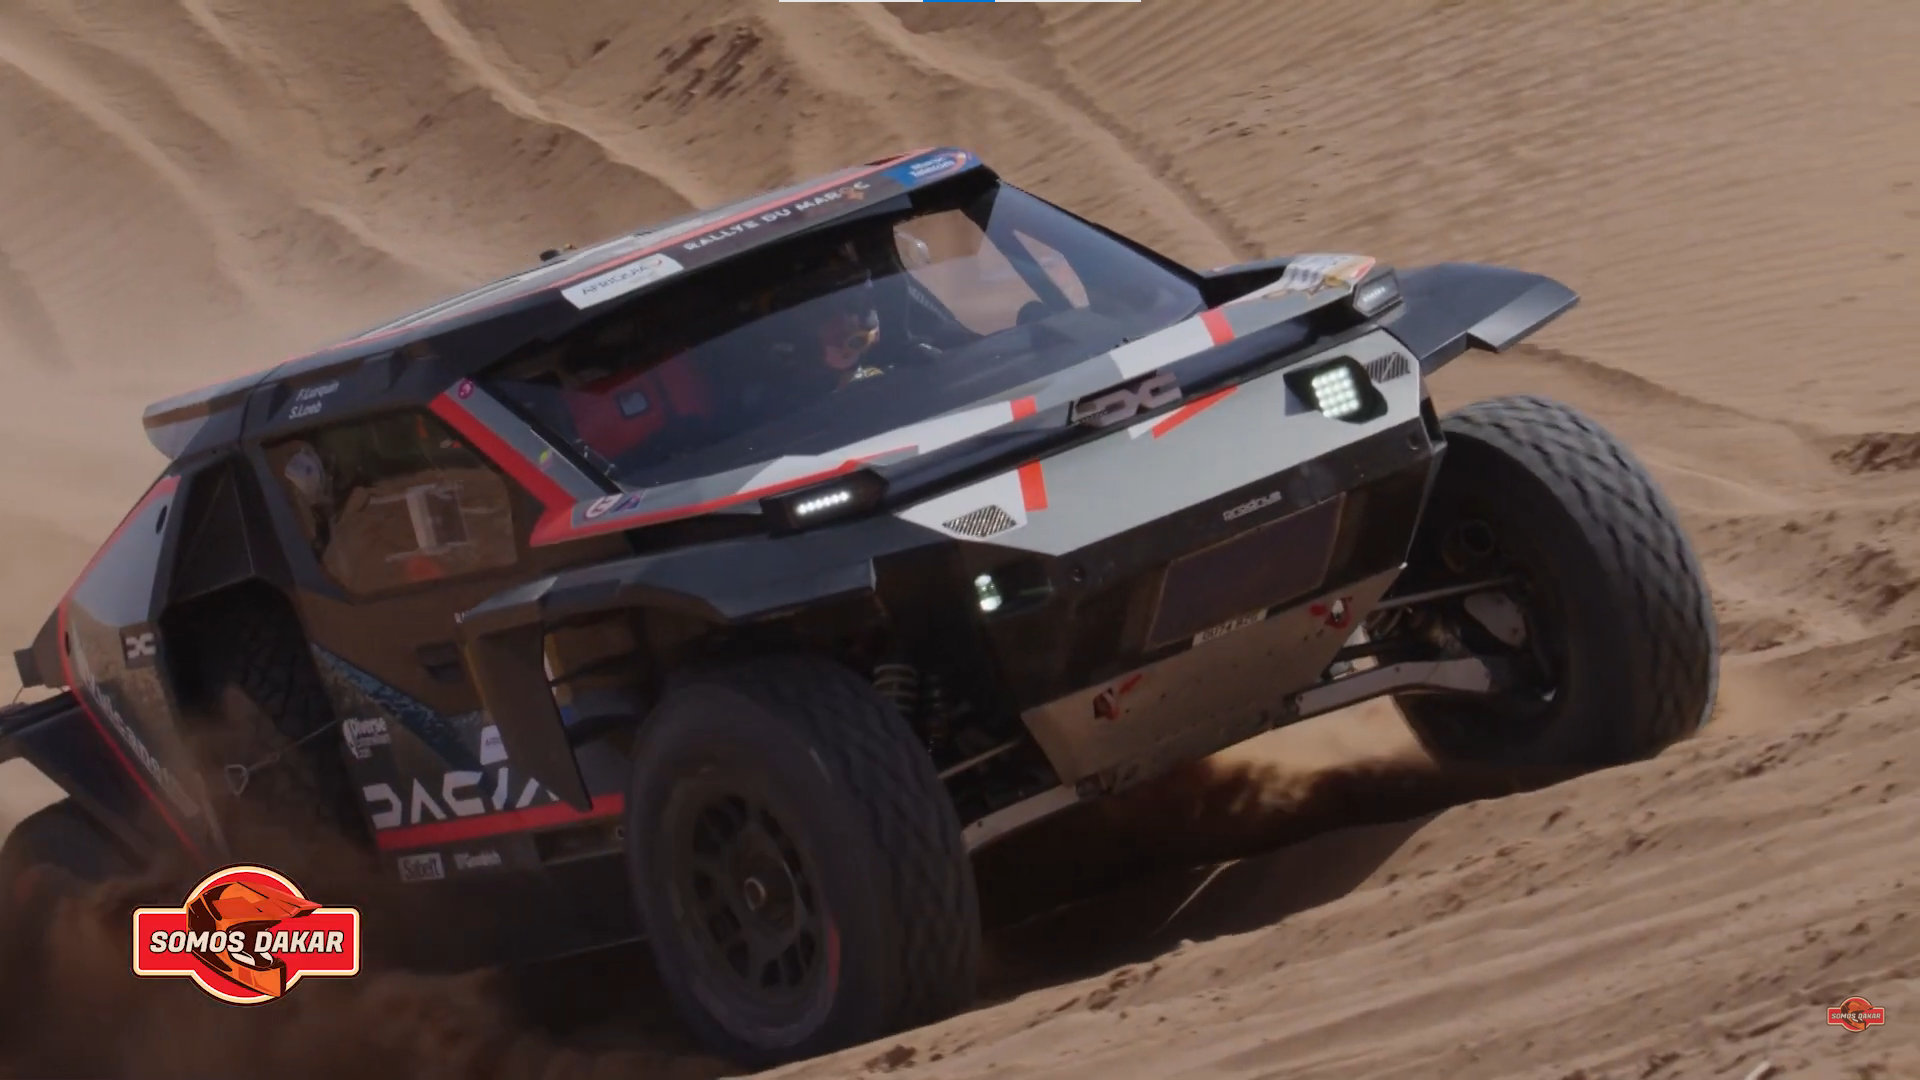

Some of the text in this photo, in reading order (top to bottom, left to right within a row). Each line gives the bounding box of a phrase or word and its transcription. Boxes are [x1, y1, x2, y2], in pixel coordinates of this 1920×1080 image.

[683, 181, 870, 251] RALLYE DU MARC
